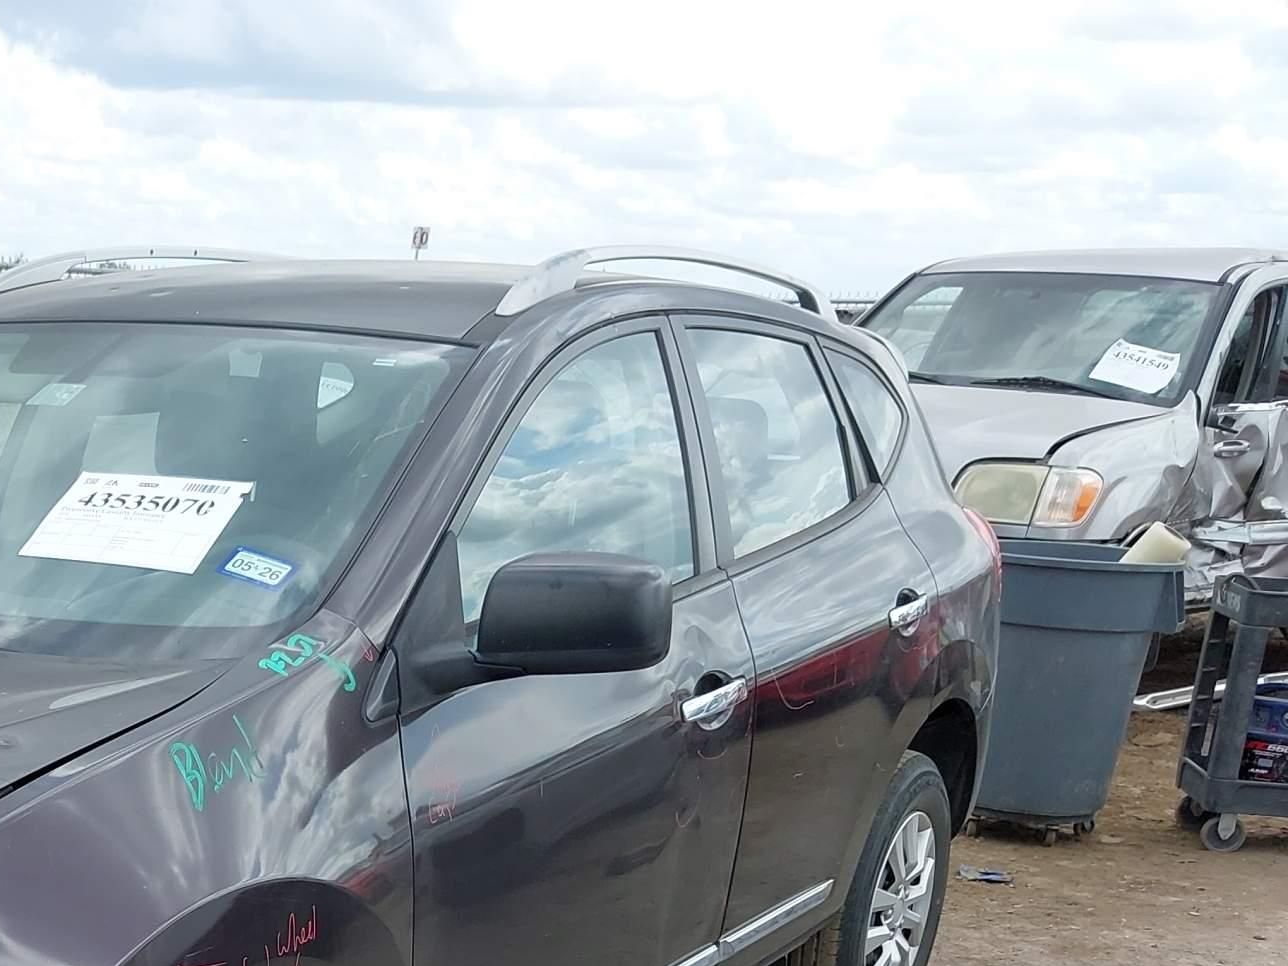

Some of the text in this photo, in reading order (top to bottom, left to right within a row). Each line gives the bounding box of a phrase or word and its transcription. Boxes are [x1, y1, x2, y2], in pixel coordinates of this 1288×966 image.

[78, 491, 216, 516] 43535070
[231, 558, 283, 581] 05 26
